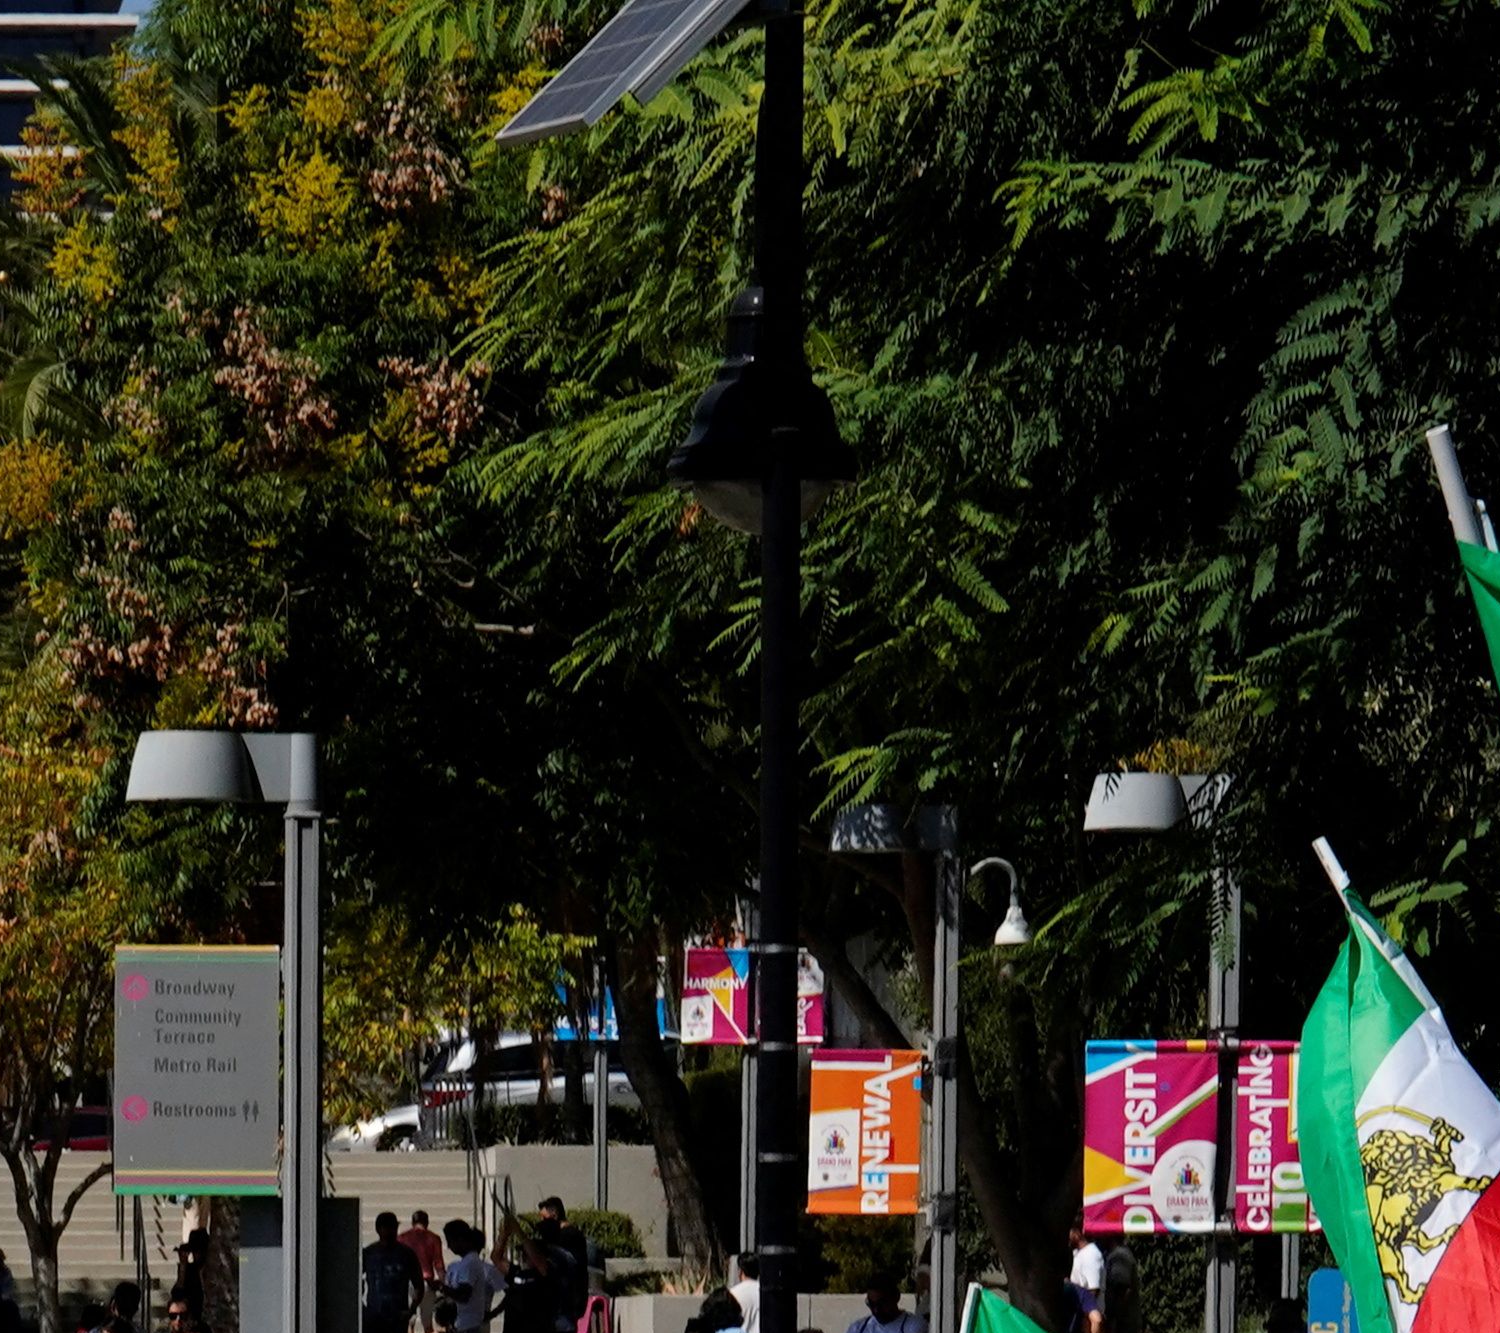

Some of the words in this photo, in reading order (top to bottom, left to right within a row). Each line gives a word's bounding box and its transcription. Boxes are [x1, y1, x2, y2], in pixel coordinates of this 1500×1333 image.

[154, 979, 235, 998] Broadway
[683, 976, 748, 990] HARMONY
[155, 1008, 241, 1028] Community
[154, 1028, 216, 1045] Terrace
[154, 1057, 201, 1073] Metro
[206, 1057, 238, 1073] Rail
[153, 1101, 237, 1118] Restrooms
[860, 1053, 893, 1214] RENEWAL
